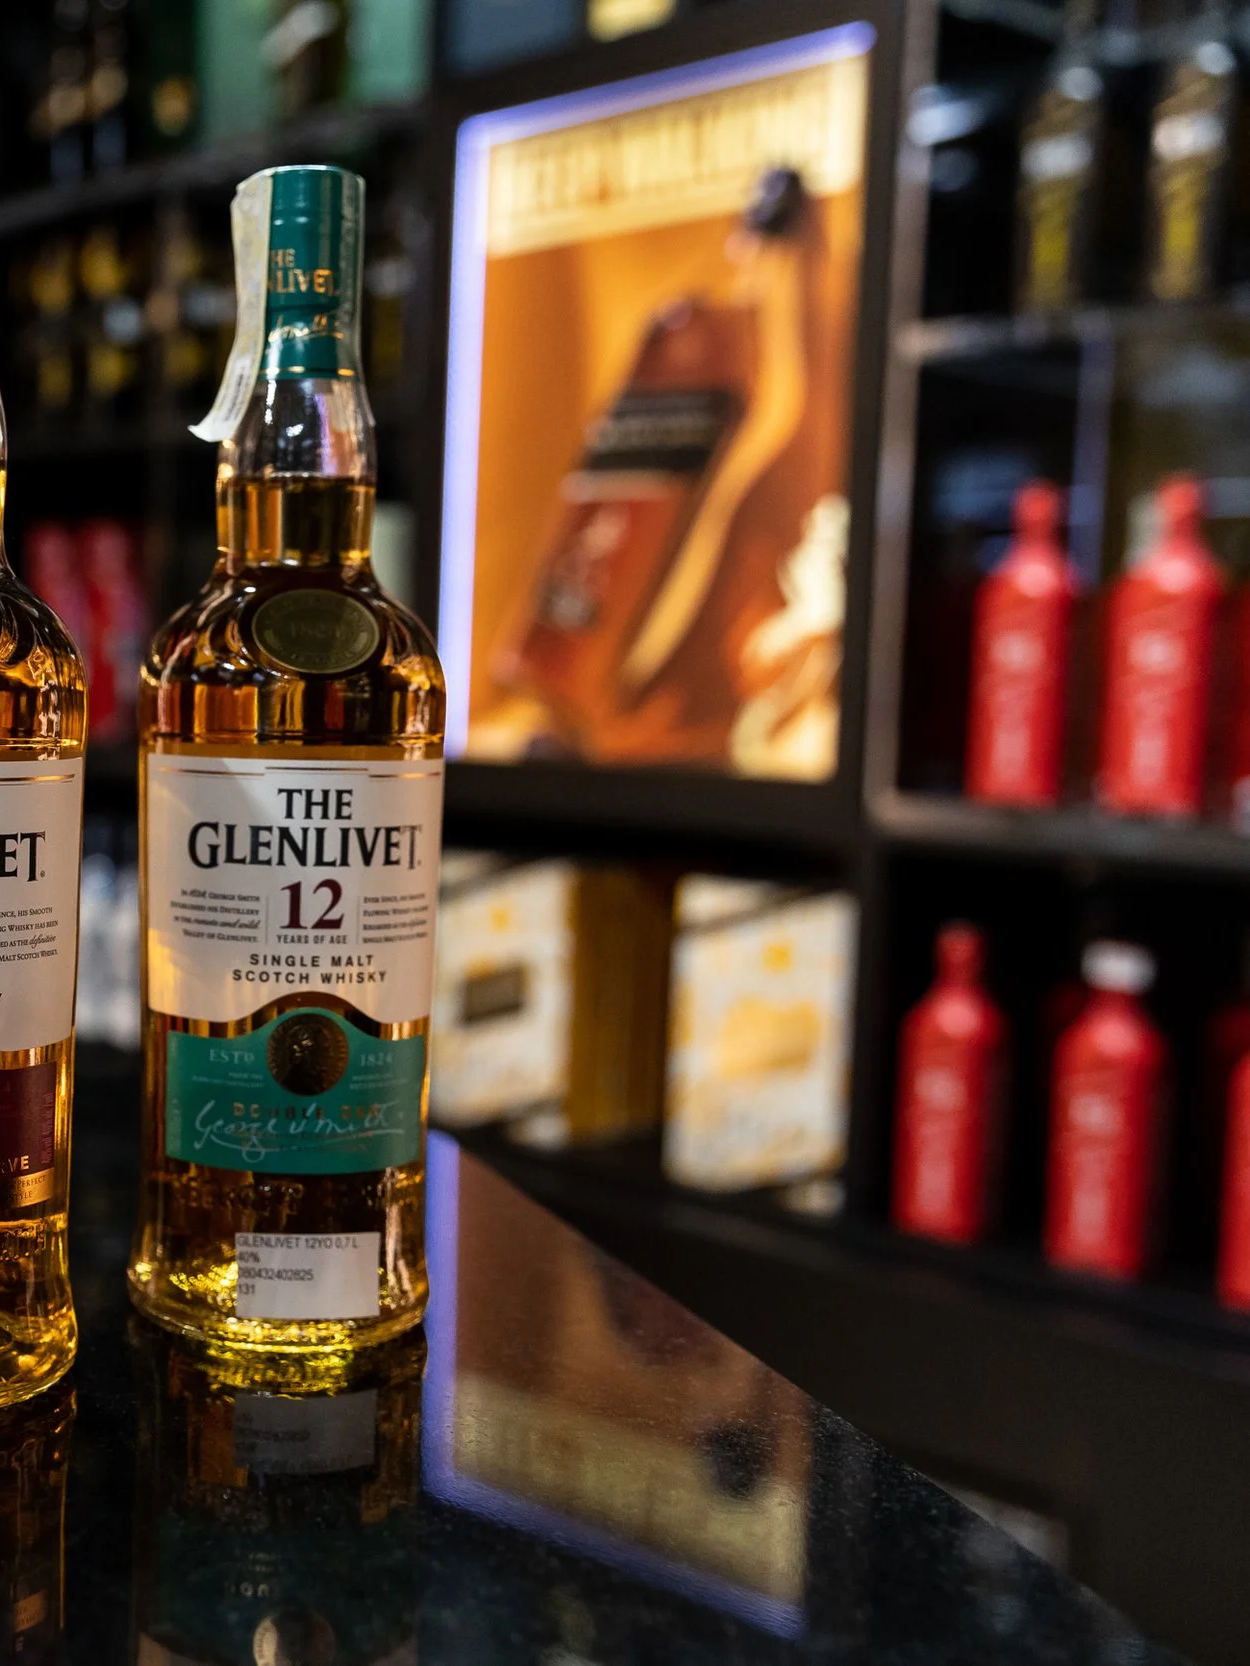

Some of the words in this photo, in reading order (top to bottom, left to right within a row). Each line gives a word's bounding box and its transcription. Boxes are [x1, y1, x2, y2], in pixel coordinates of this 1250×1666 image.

[270, 249, 295, 267] HE
[277, 788, 353, 820] THE
[188, 822, 422, 871] GLENLIVET
[280, 878, 345, 930] 12
[29, 907, 53, 916] SMOOTH
[8, 924, 35, 932] WHISKY
[17, 938, 29, 946] THE
[276, 934, 309, 945] YEARS
[313, 934, 326, 945] OF
[329, 934, 348, 945] AGE
[17, 951, 40, 960] SCOTCH
[250, 954, 320, 967] SINGLE
[331, 954, 375, 967] MALT
[232, 969, 310, 984] SCOTCH
[320, 970, 387, 985] WHISKY
[237, 1236, 300, 1249] GLENLIVET
[304, 1237, 333, 1249] 12YO
[237, 1251, 259, 1263] 40%
[238, 1285, 256, 1295] 131
